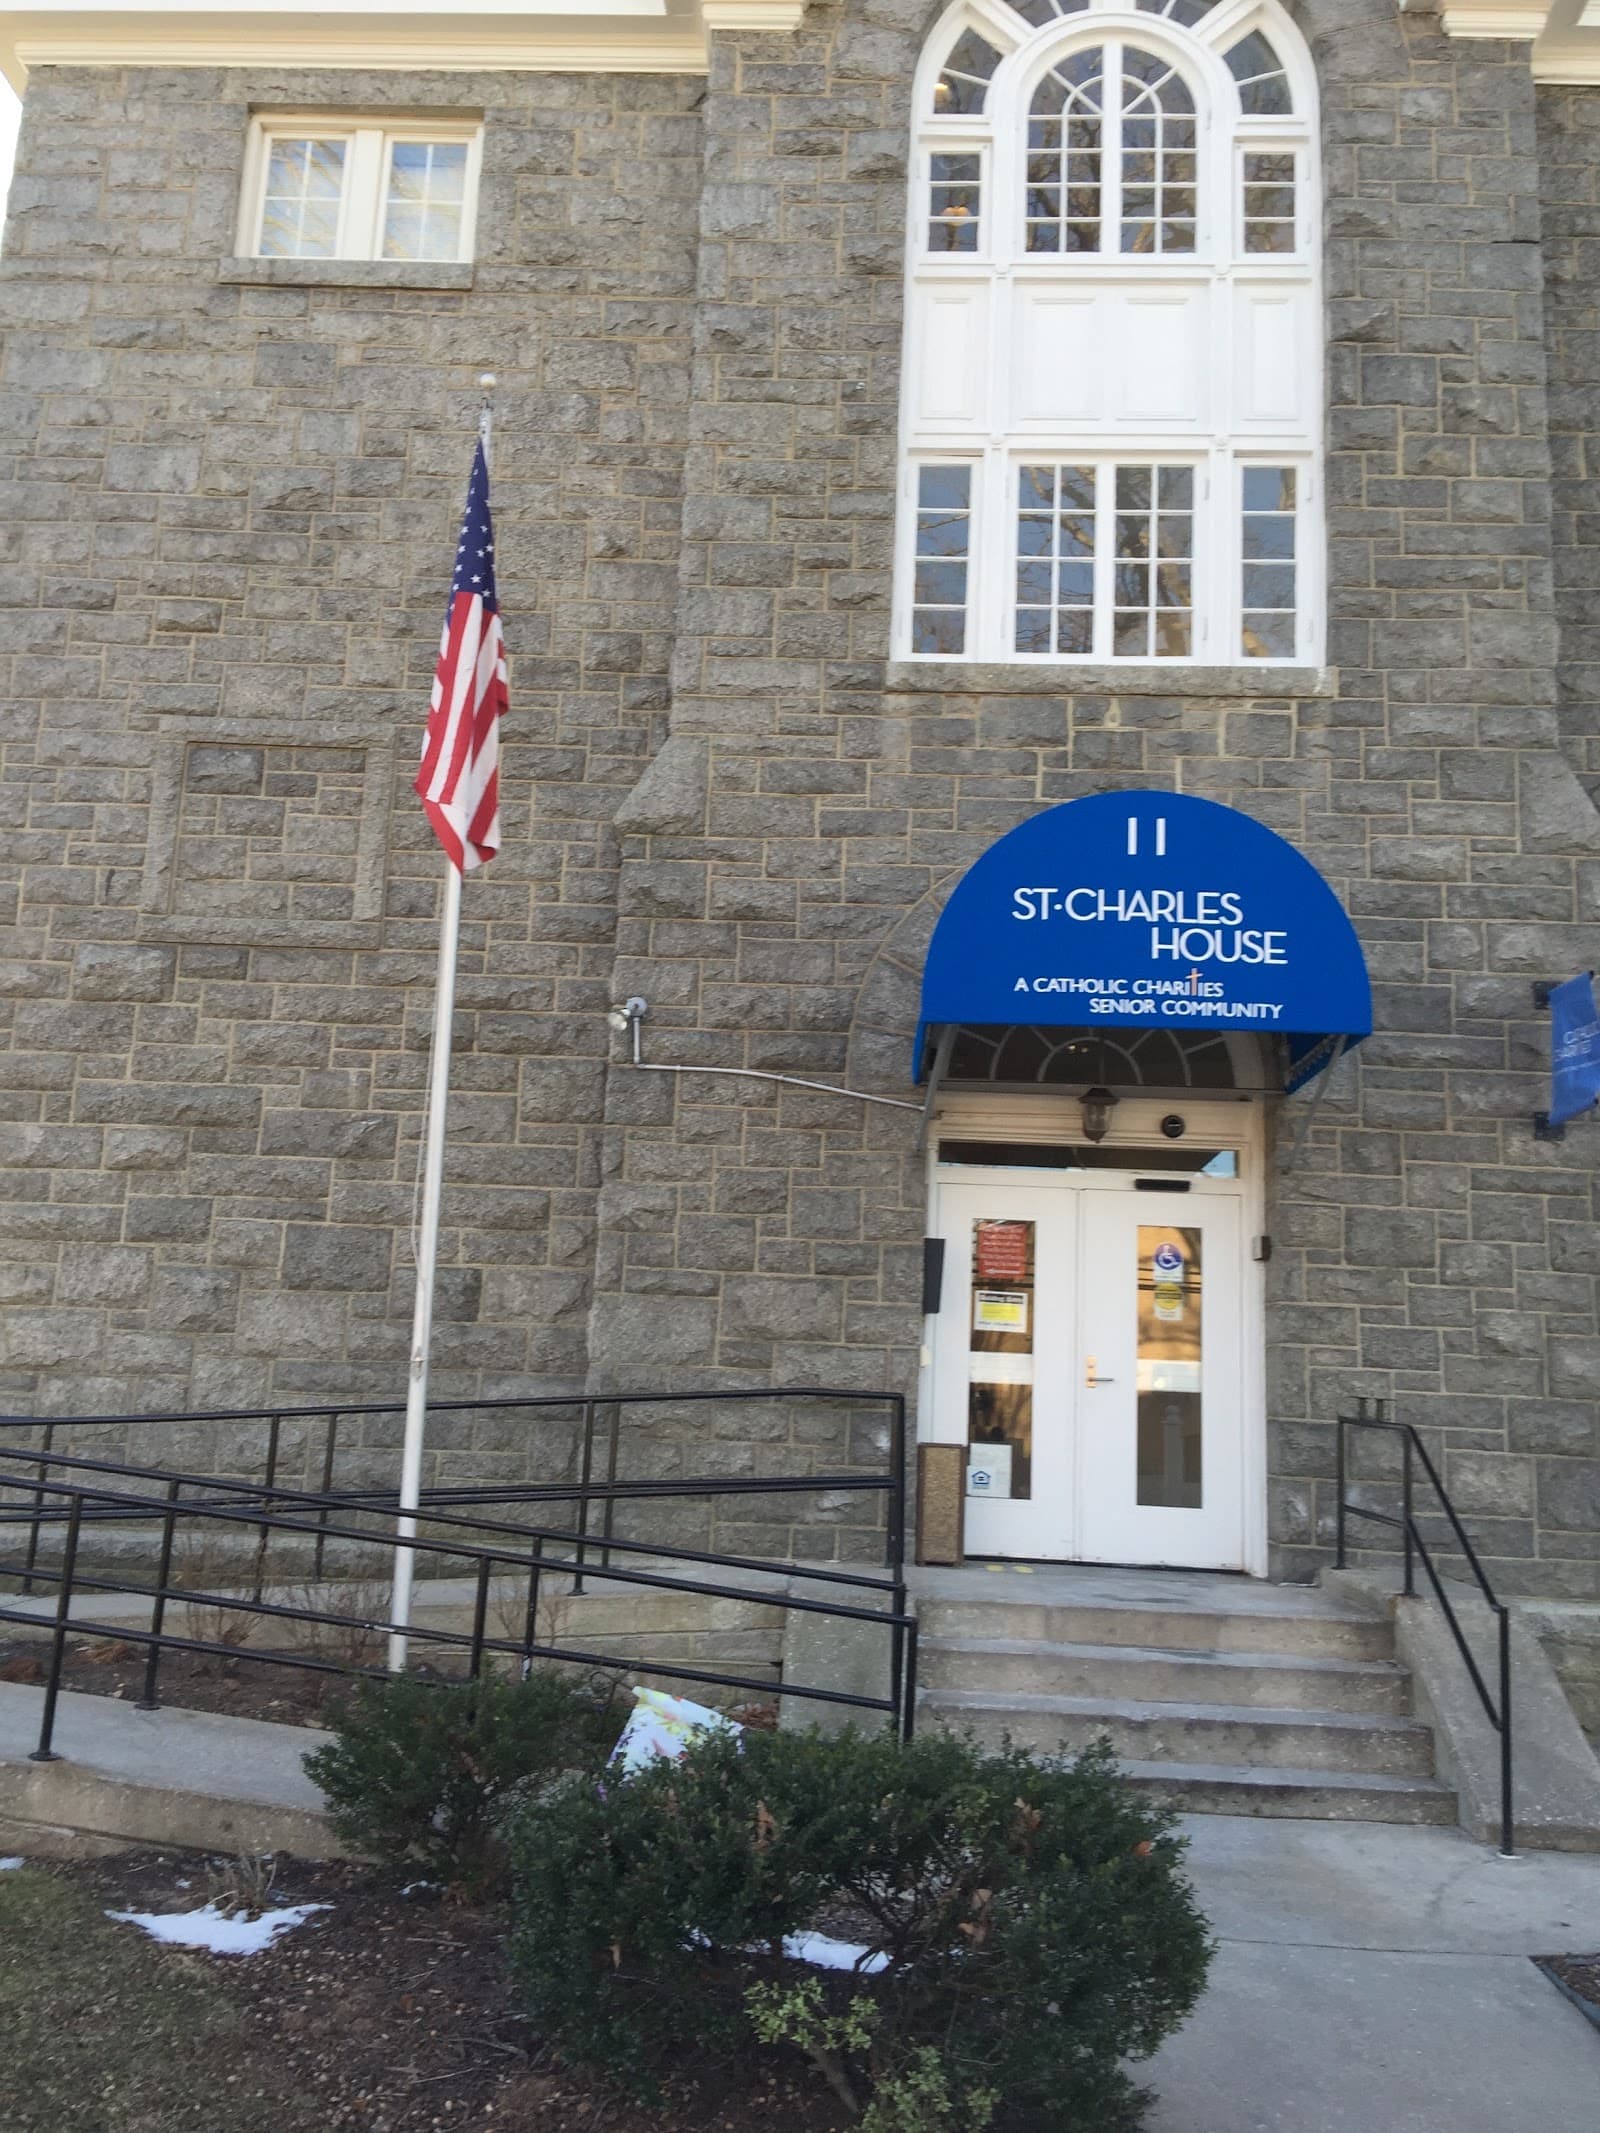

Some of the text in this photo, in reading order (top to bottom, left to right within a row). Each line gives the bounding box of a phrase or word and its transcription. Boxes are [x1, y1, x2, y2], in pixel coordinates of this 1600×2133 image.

[1127, 817, 1166, 856] 11
[1151, 926, 1288, 964] HOUSE
[1014, 968, 1224, 998] A CATHOLIC CHARITIES
[1089, 998, 1283, 1019] SENIOR COMMUNITY
